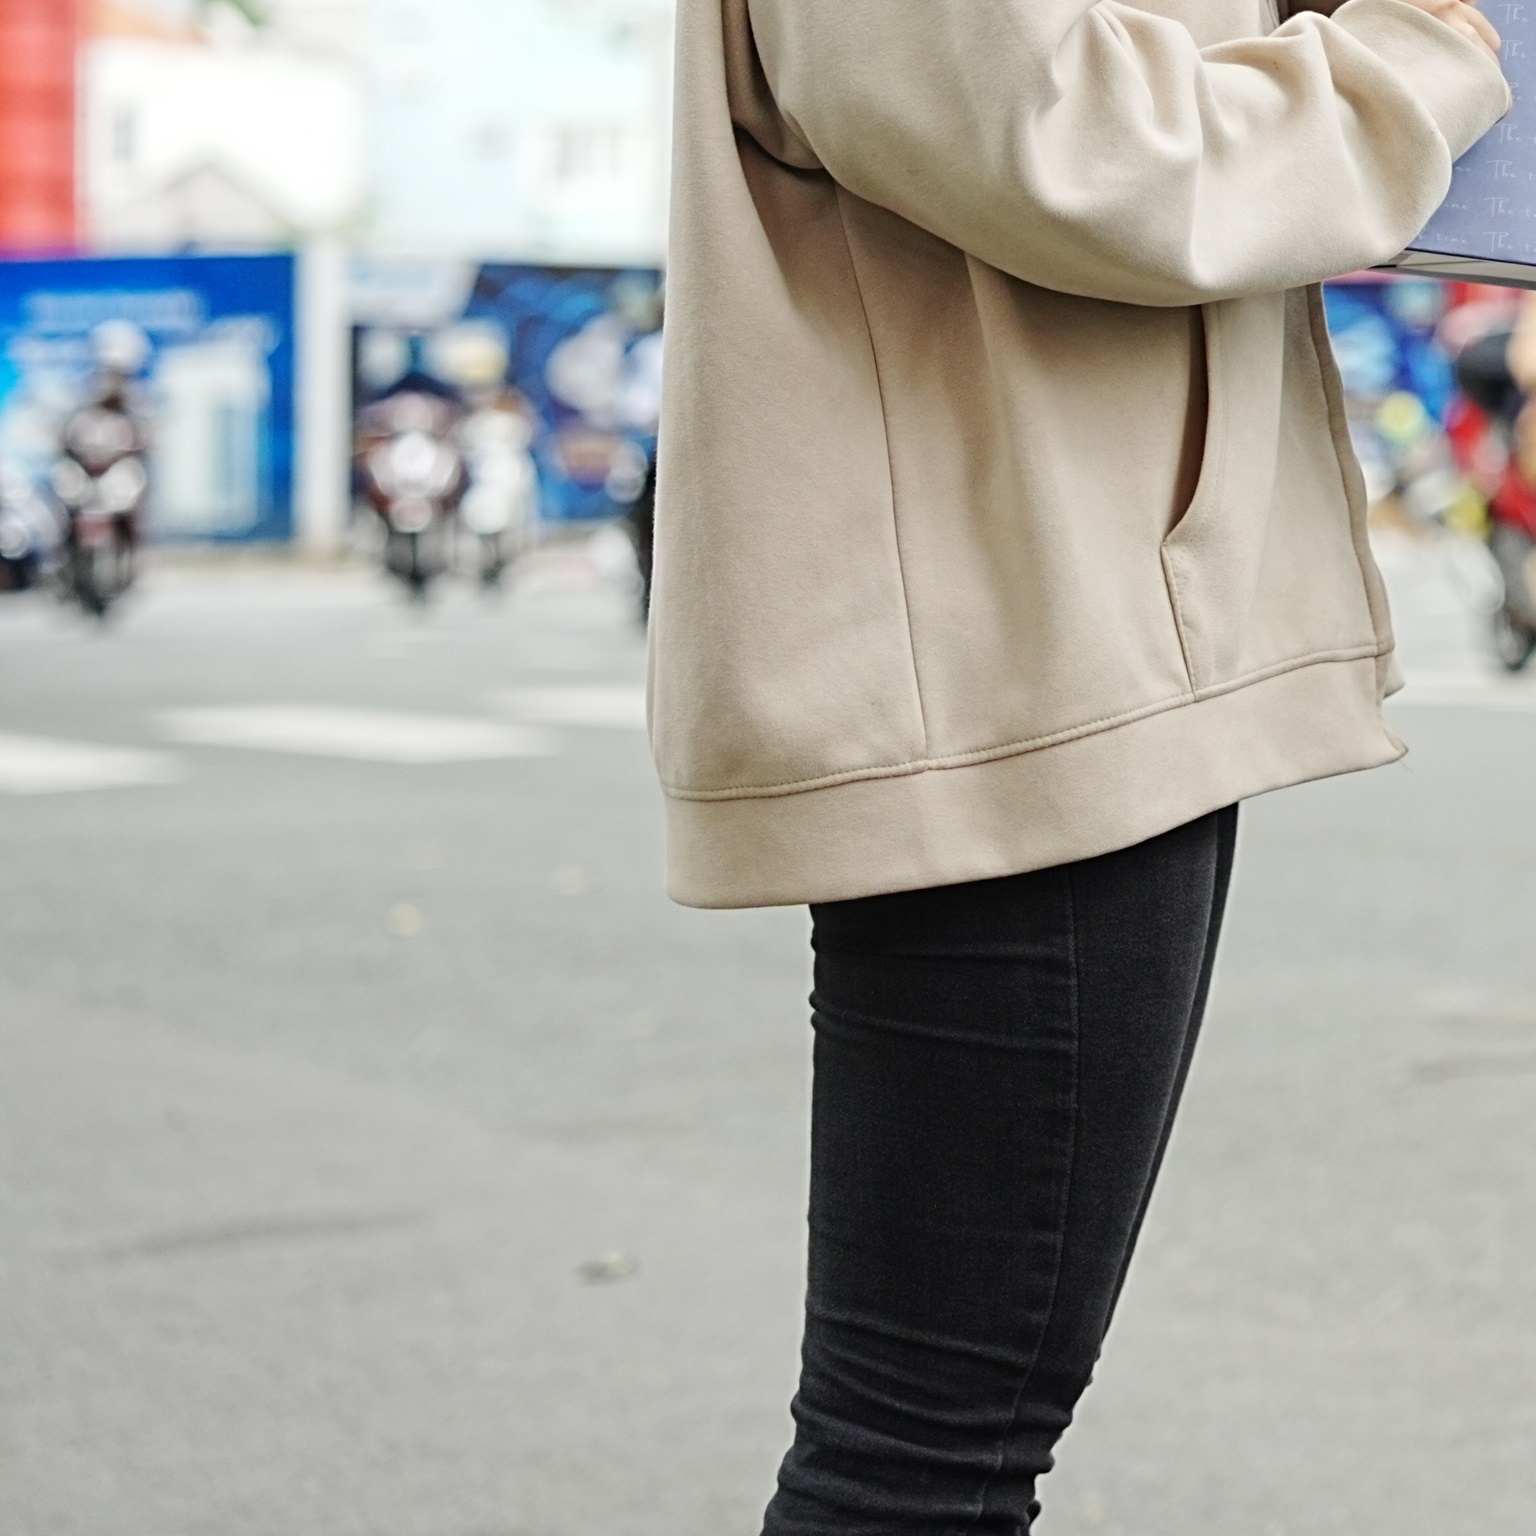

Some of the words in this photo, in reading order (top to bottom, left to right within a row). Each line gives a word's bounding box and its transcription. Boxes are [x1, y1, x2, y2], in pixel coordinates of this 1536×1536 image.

[1499, 4, 1528, 24] The
[1501, 40, 1527, 61] The
[1495, 123, 1523, 145] The
[1486, 160, 1517, 180] The
[1483, 197, 1513, 217] The
[1483, 231, 1514, 252] The
